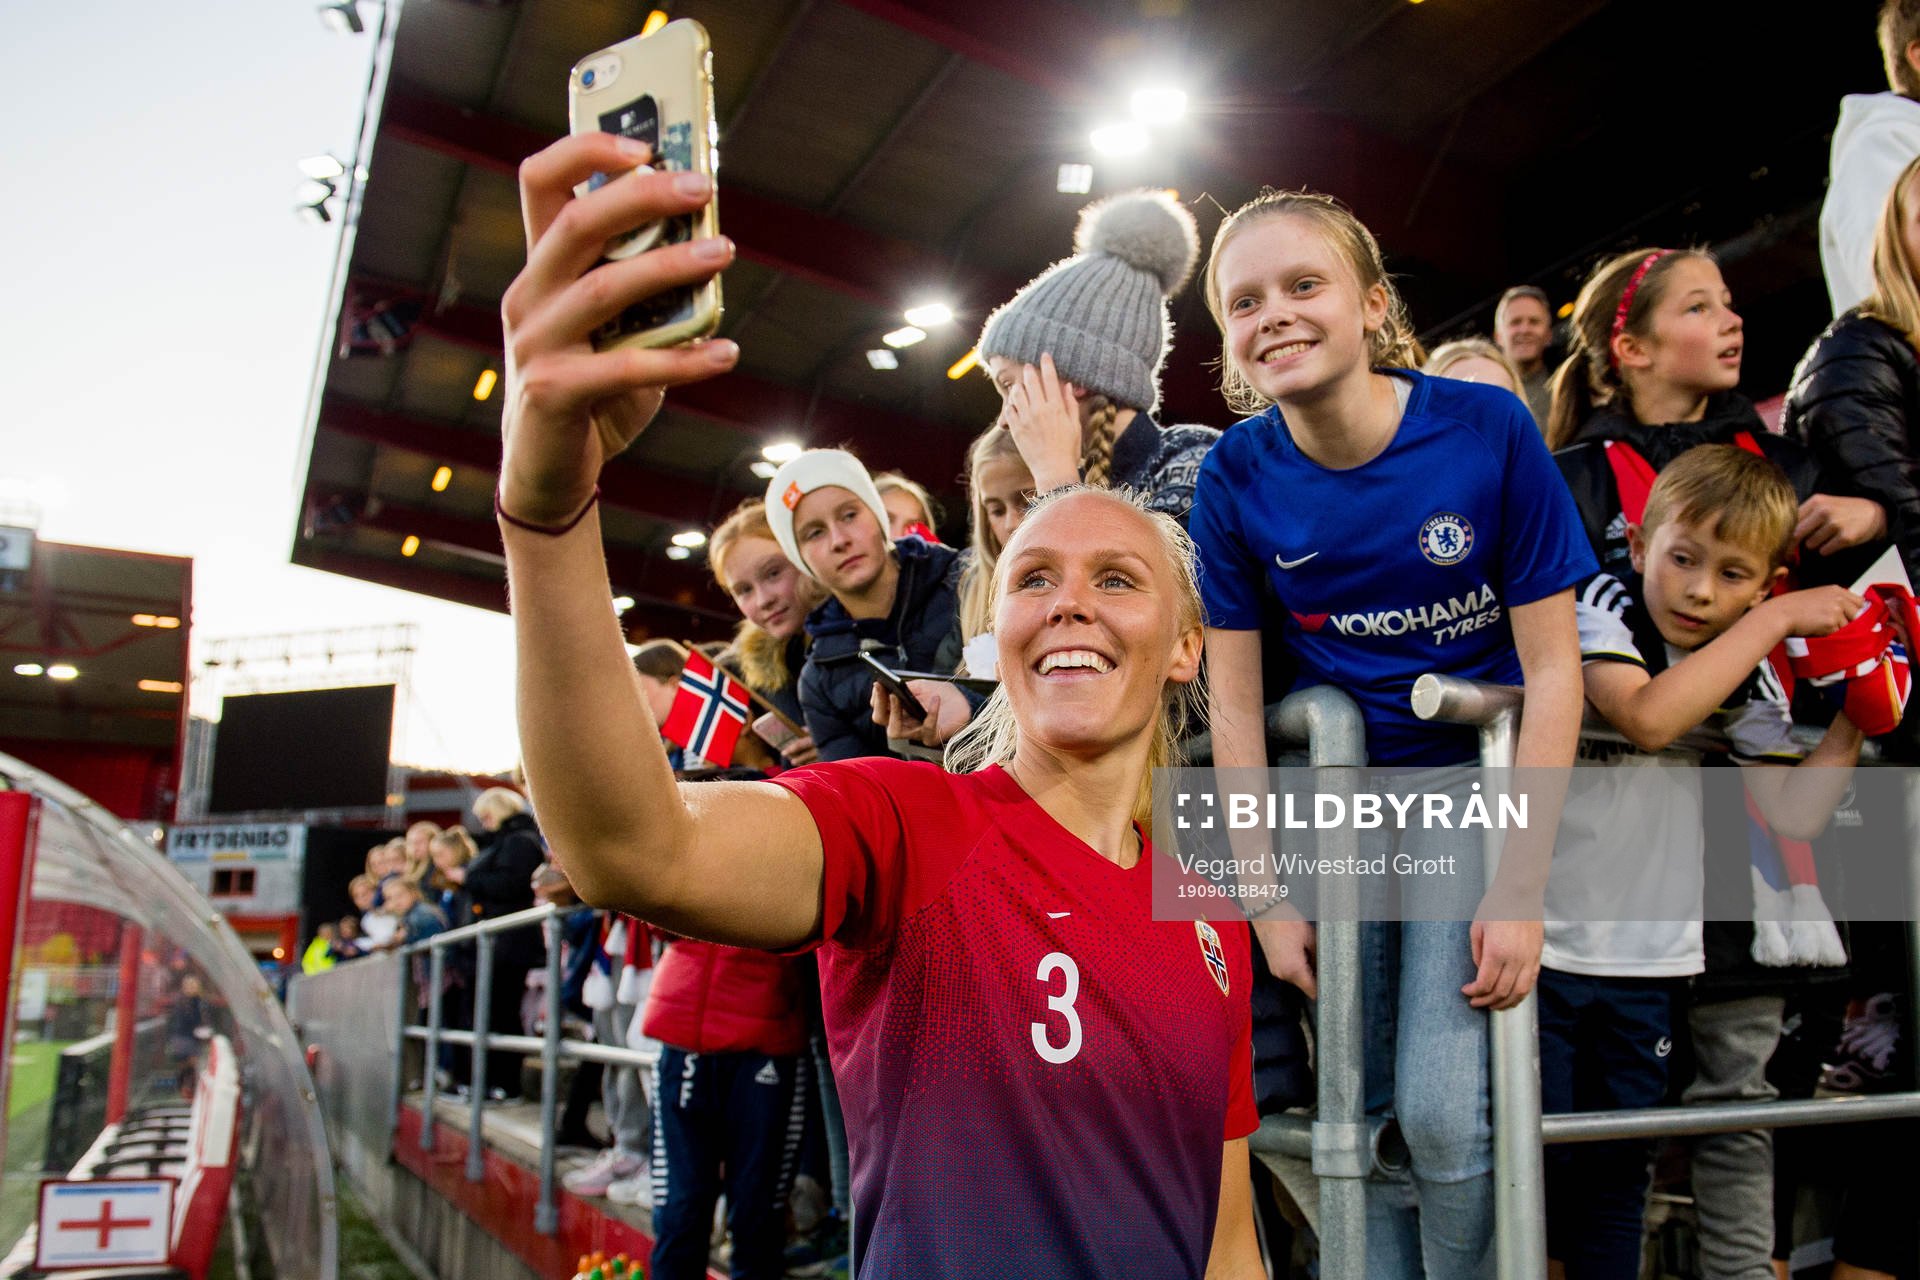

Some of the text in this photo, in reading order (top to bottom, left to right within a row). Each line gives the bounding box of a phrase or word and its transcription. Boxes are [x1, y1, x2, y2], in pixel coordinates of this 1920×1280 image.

[1425, 515, 1460, 531] CHELSEA
[1330, 583, 1496, 636] YOKOHAMA
[1433, 605, 1501, 646] TYRES
[1031, 951, 1083, 1065] 3
